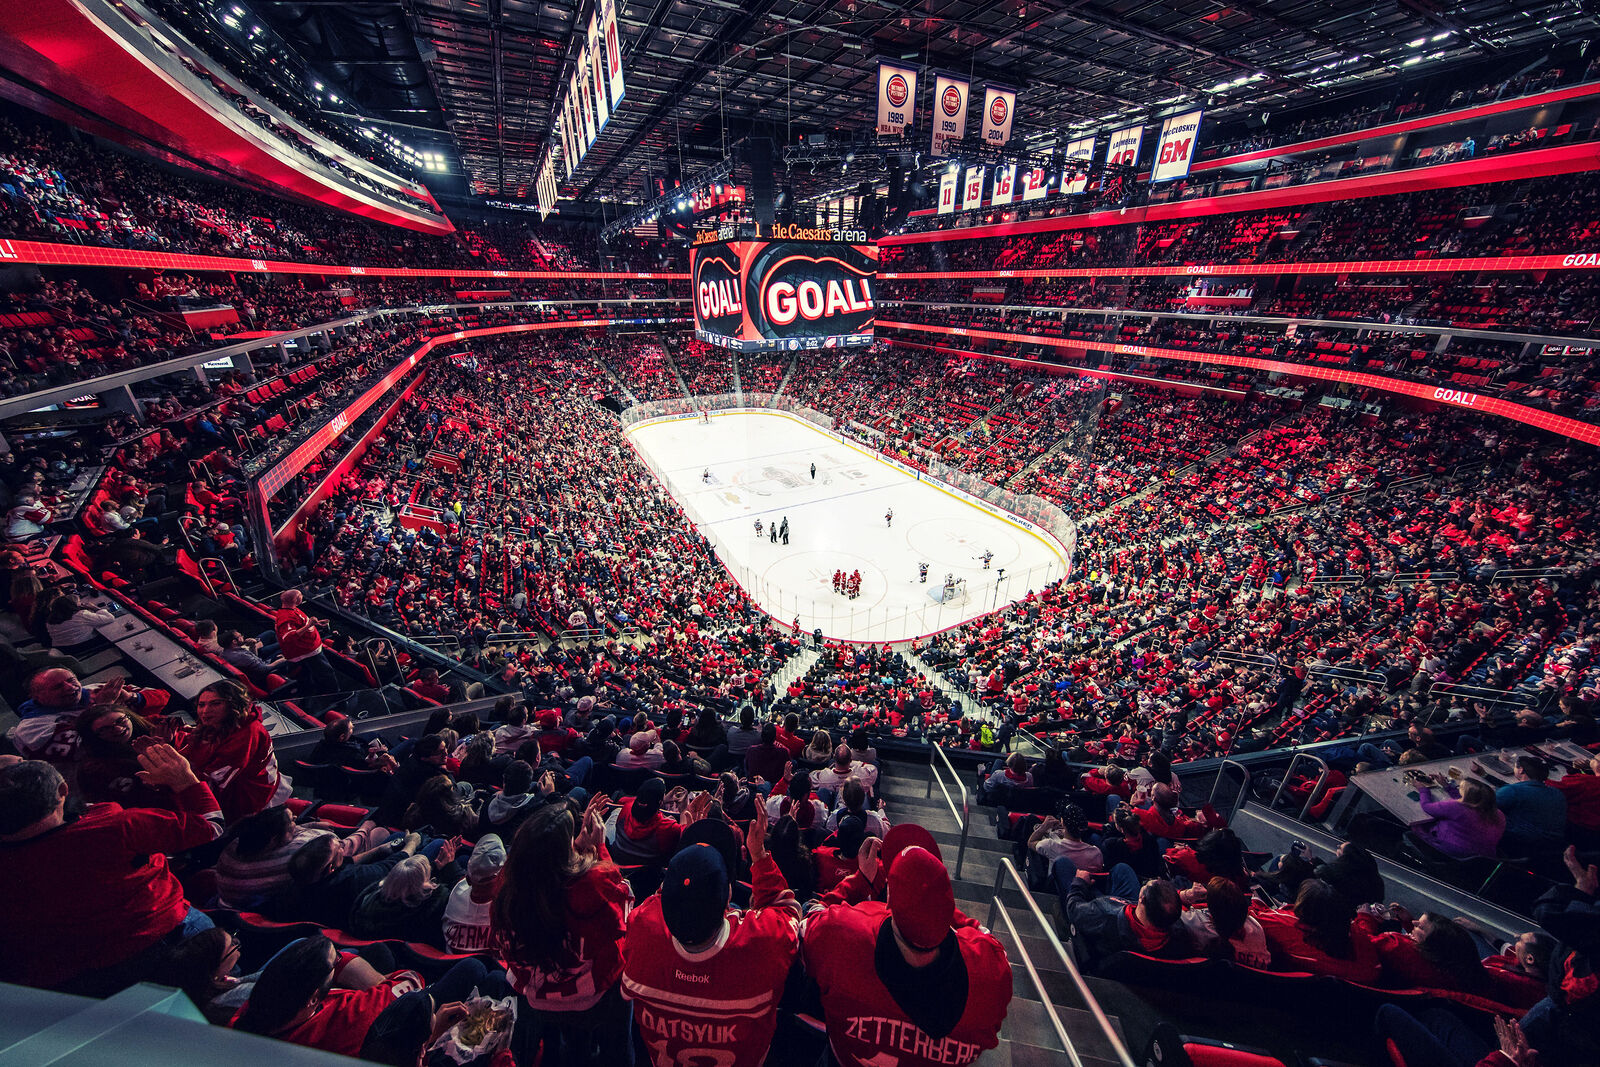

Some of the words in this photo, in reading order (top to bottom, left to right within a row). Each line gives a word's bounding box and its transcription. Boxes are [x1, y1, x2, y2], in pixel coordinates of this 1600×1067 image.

[887, 112, 904, 124] 1989
[942, 120, 957, 132] 1990
[988, 129, 1004, 140] 2004
[1160, 138, 1192, 164] GM
[943, 188, 952, 206] 11
[967, 182, 980, 201] 15
[788, 223, 832, 240] Caesars
[833, 230, 866, 242] arena
[252, 260, 268, 270] GOAL!
[1562, 254, 1600, 266] GOA
[1186, 266, 1214, 274] GOAL!
[700, 278, 742, 318] GOAL!
[768, 278, 874, 324] GOAL!
[780, 340, 785, 350] 1
[840, 338, 844, 346] 1
[1122, 344, 1147, 354] GOAL!
[1433, 387, 1478, 406] GOAL!
[1007, 514, 1033, 529] FALKEN
[675, 969, 710, 984] Reebok
[642, 1007, 736, 1044] DATSYUK
[845, 1016, 980, 1064] ZETTERBERG
